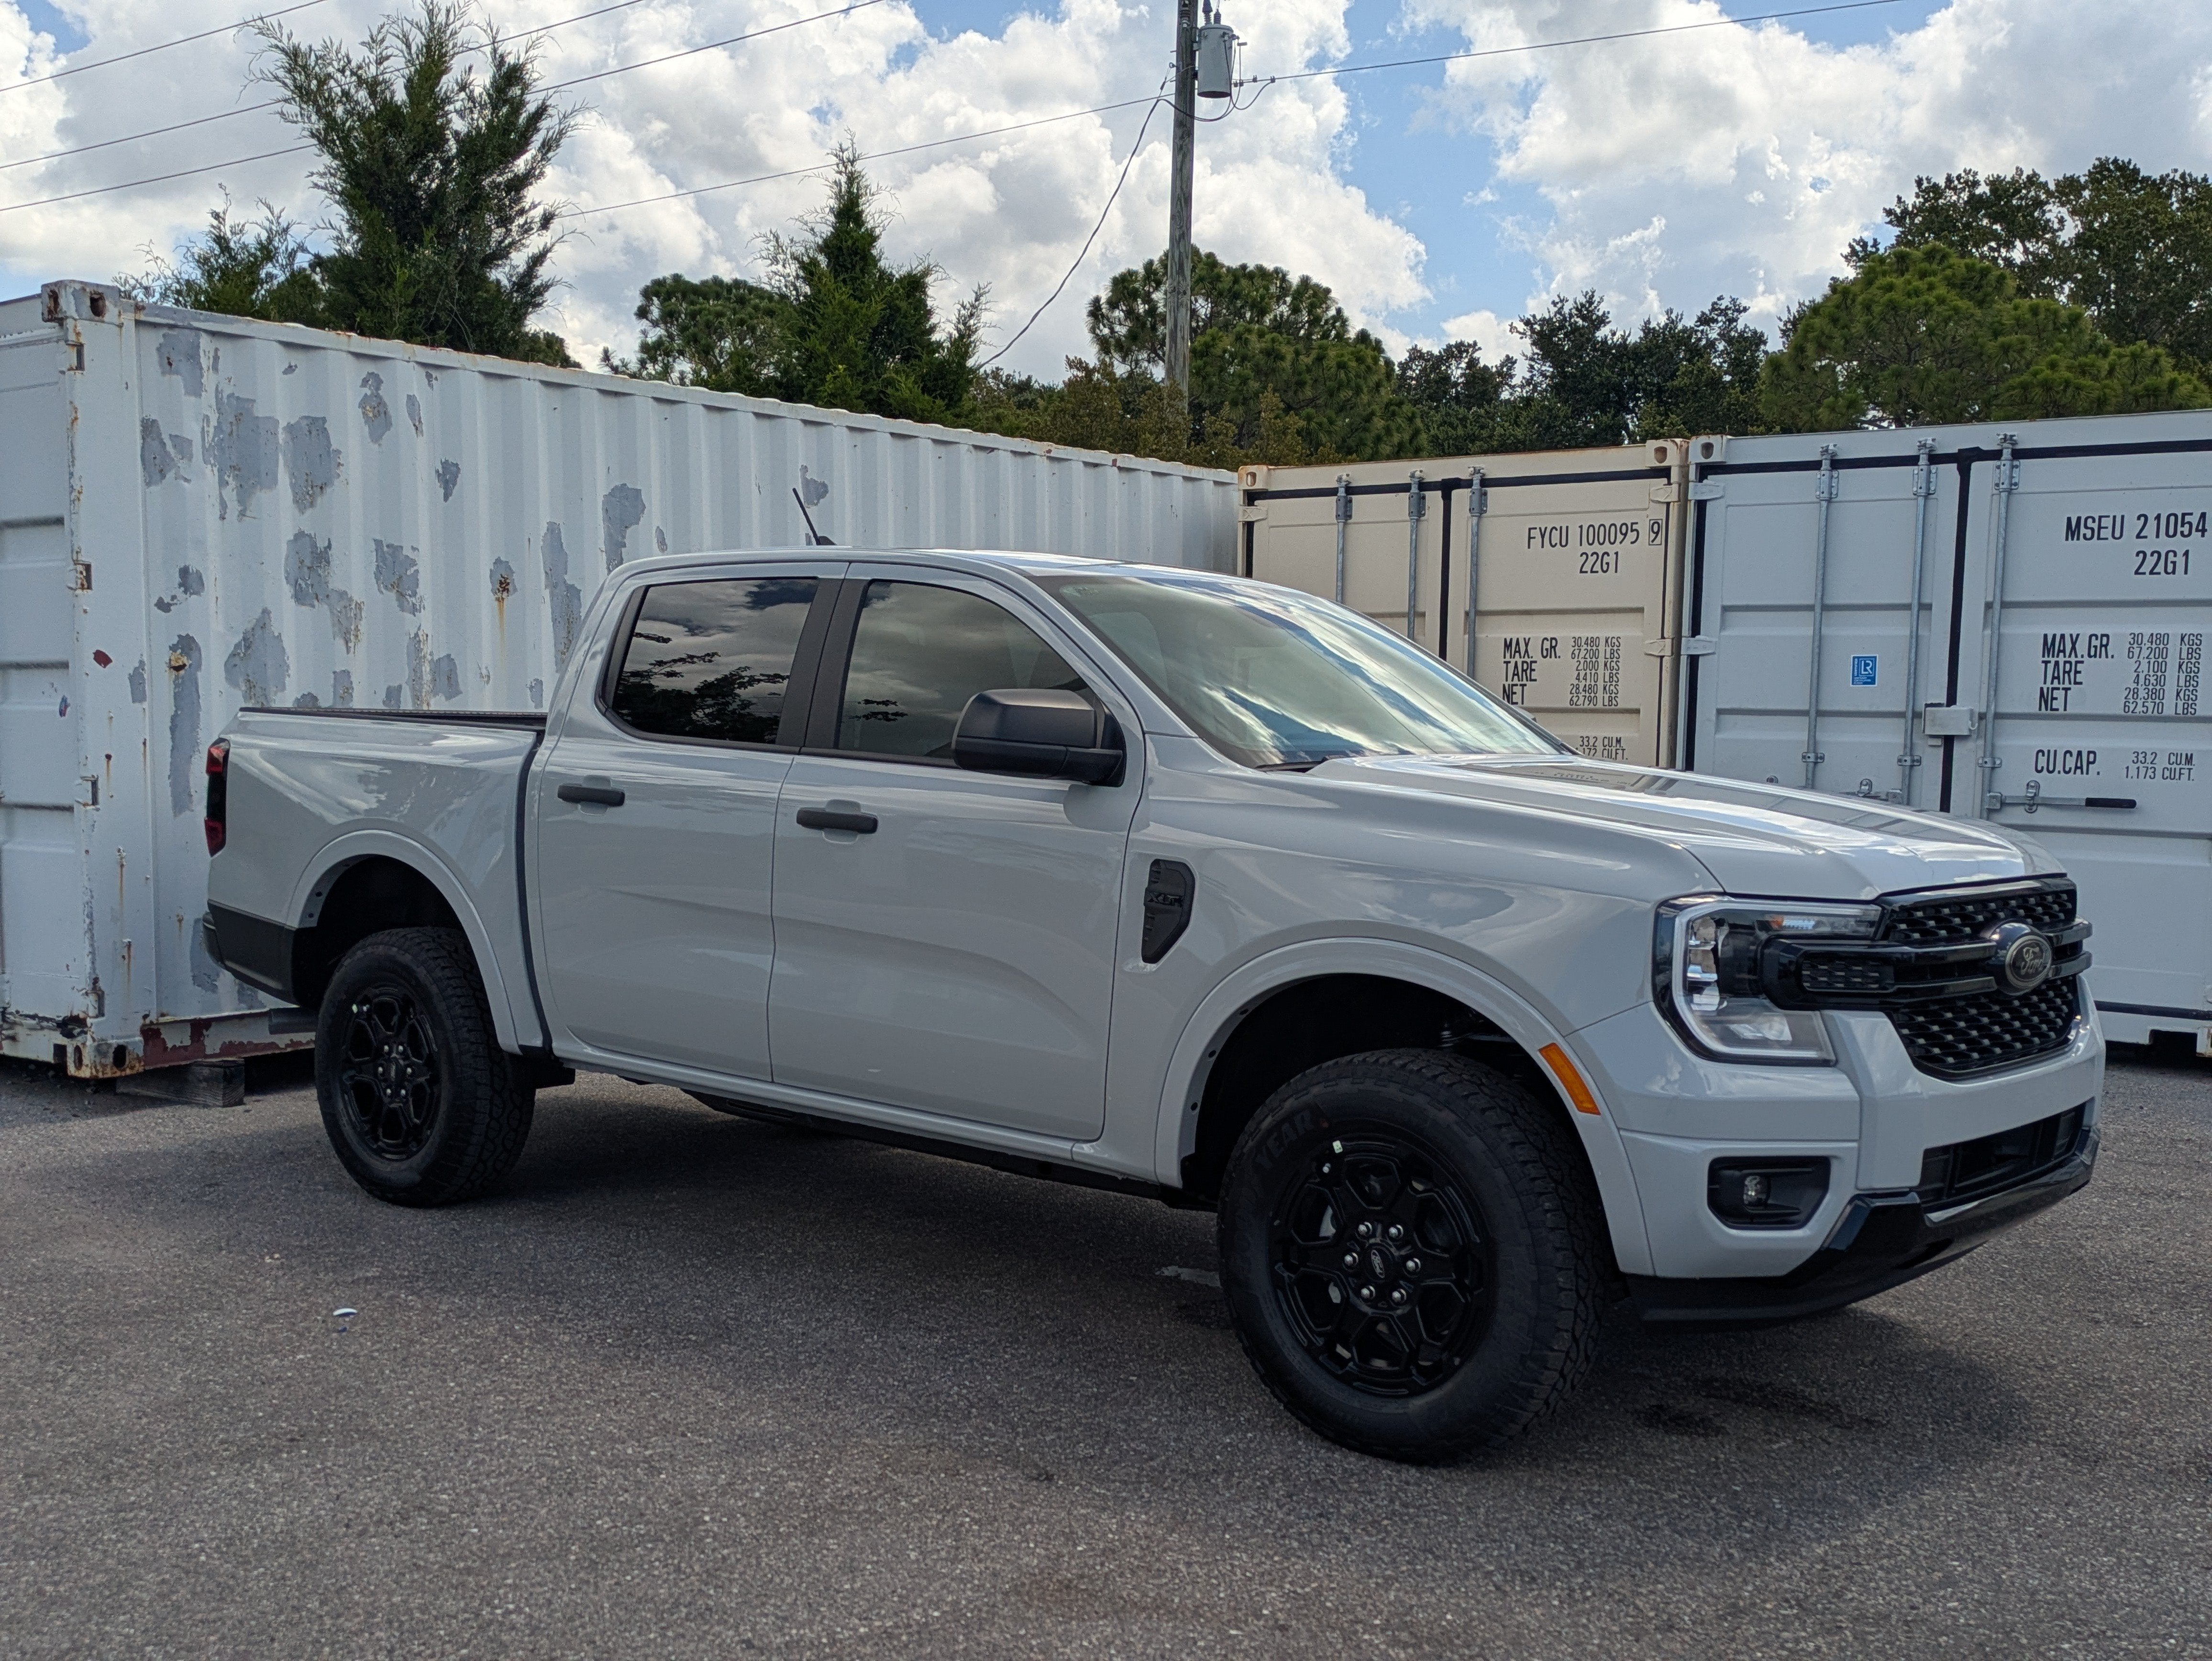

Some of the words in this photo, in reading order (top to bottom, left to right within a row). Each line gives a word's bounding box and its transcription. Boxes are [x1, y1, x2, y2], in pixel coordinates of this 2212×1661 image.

[2065, 514, 2125, 542] MSEU
[2135, 511, 2208, 540] 21054
[1527, 525, 1569, 549] FYCU
[1578, 522, 1640, 547] 100095
[1651, 521, 1661, 543] 9
[1579, 551, 1619, 574] 22G1
[2134, 549, 2190, 576] 22G1
[1604, 636, 1621, 648] KGS
[2180, 633, 2202, 646] KGS
[1503, 637, 1534, 659] MAX.
[1540, 637, 1561, 659] GR.
[1604, 648, 1621, 660] LBS
[2179, 647, 2201, 660] LBS
[1503, 660, 1537, 683] TARE
[1604, 660, 1620, 672] KGS
[2041, 660, 2084, 686] TARE
[2178, 661, 2200, 675] KGS
[1603, 672, 1620, 684] LBS
[2177, 674, 2199, 688] LBS
[1502, 683, 1527, 706] NET
[1603, 683, 1619, 695] KGS
[2176, 688, 2198, 701] KGS
[1602, 695, 1619, 707] LBS
[2038, 687, 2071, 712] NET
[2174, 701, 2197, 715] LBS
[1579, 736, 1598, 747] 33.2
[1602, 736, 1624, 748] CU.M.
[2035, 749, 2101, 776] CU.CAP.
[2132, 751, 2157, 765] 33.2
[2168, 752, 2196, 766] CU.M.
